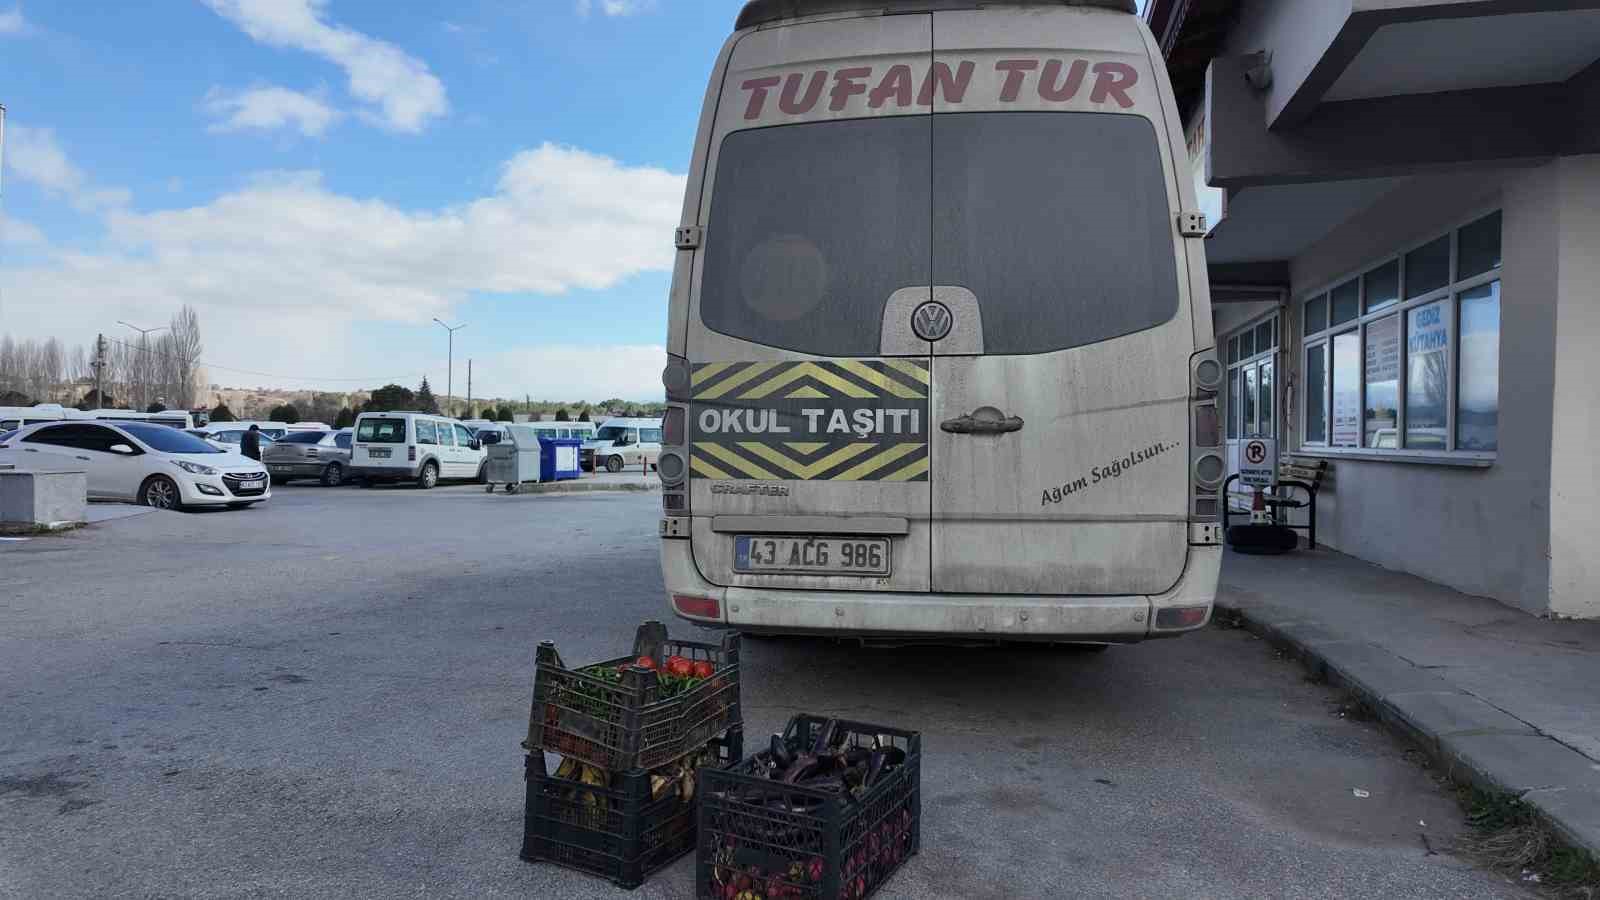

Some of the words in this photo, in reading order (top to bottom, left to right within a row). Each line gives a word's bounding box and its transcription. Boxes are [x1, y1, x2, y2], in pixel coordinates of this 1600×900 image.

[741, 61, 975, 120] TUFAN
[996, 60, 1139, 109] TUR
[699, 408, 791, 434] OKUL
[801, 408, 920, 438] TAŞITI
[710, 483, 790, 497] CRAFTER
[1041, 475, 1089, 506] Ağam
[751, 541, 777, 564] 43
[788, 541, 829, 566] ACG
[841, 543, 882, 568] 986
